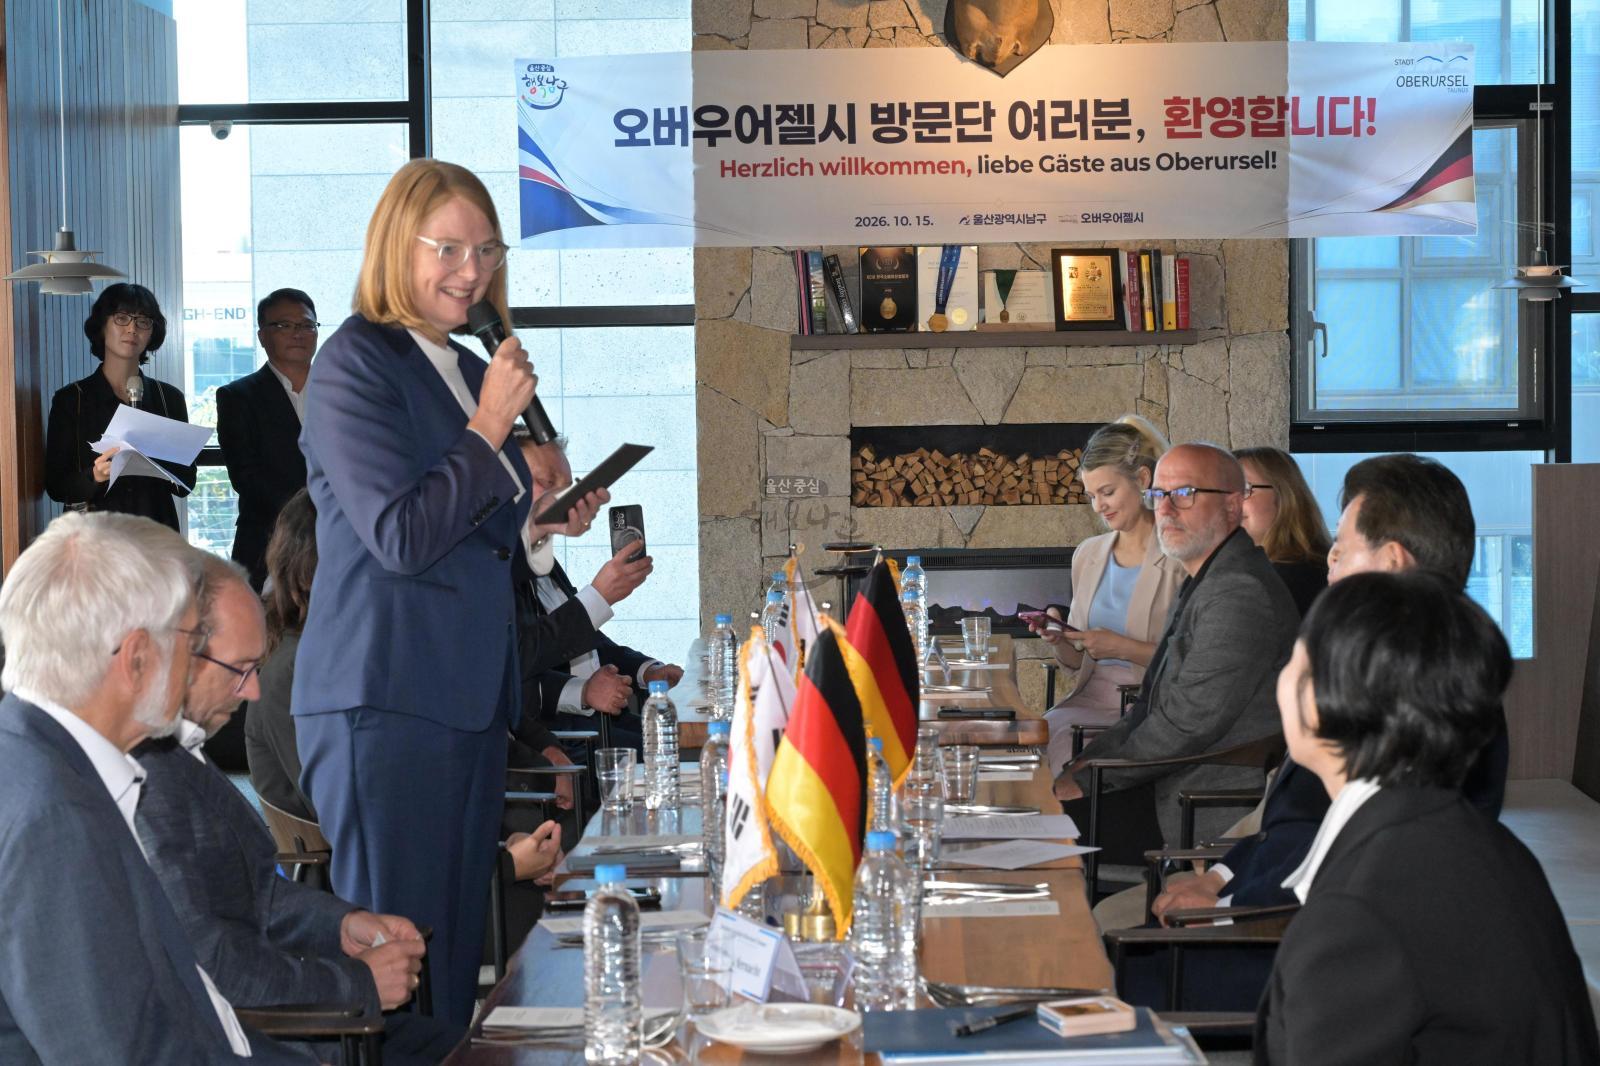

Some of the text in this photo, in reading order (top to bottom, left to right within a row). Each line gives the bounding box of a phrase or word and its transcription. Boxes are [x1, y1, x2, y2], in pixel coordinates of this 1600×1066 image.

[1394, 58, 1415, 66] STADT
[1396, 75, 1469, 87] OBERURSEL
[613, 95, 1377, 147] 오버우어젤시 방문단 여러분, 환영합니다!
[720, 151, 1277, 178] Herzlich willkommen, liebe Gäste aus Oberursel!
[855, 215, 934, 227] 2026. 10. 15.
[973, 213, 1047, 225] 울산광역시남구
[1080, 212, 1144, 224] 오버우어젤시
